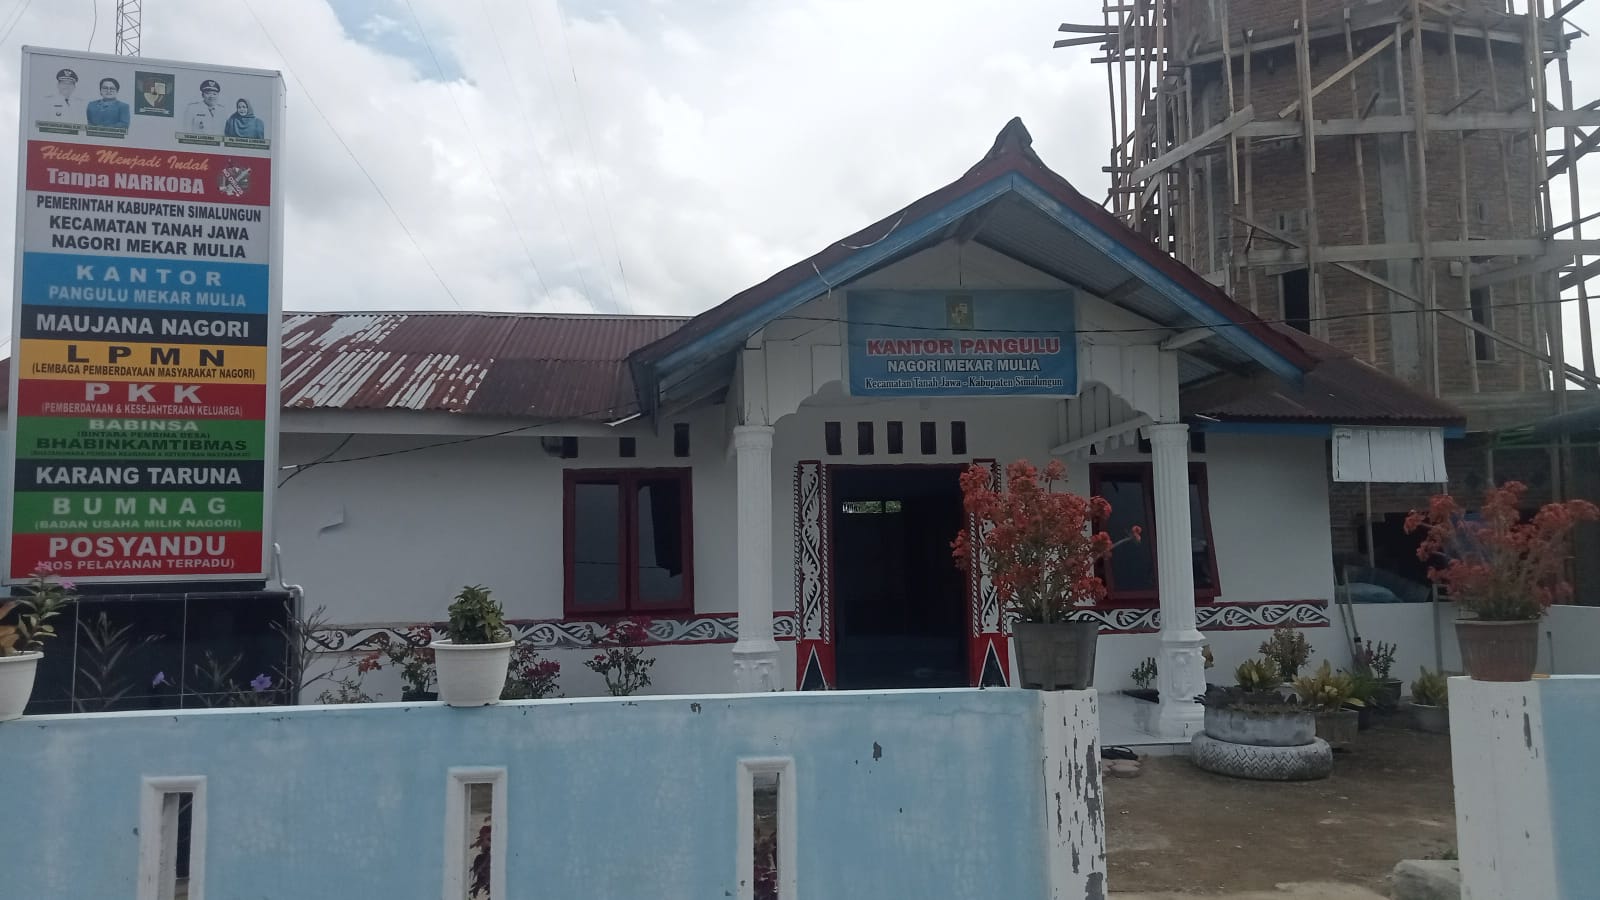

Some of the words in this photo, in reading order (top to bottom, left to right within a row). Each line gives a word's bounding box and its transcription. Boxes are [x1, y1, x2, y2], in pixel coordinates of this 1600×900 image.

[40, 145, 90, 164] Hidup
[96, 150, 161, 168] Menjadi
[168, 155, 208, 171] Indah
[47, 168, 109, 188] Tanpa
[115, 172, 204, 194] NARKOBA
[37, 195, 113, 213] PEMERINTAH
[117, 200, 184, 217] KABUPATEN
[188, 206, 261, 222] SIMALUNGUN
[50, 216, 146, 234] KECAMATAN
[152, 222, 203, 237] TANAH
[208, 226, 249, 240] JAWA
[52, 235, 120, 251] NAGORI
[127, 239, 186, 255] MEKAR
[193, 243, 246, 258] MULIA
[50, 286, 128, 302] PANGULU
[134, 290, 190, 304] MEKAR
[197, 293, 246, 307] MULIA
[36, 314, 154, 335] MAUJANA
[162, 319, 248, 337] NAGORI
[867, 339, 953, 356] KANTOR
[960, 337, 1060, 355] PANGULU
[33, 365, 80, 375] (LEMBAGA
[83, 366, 154, 376] PEMBERDAYAAN
[158, 368, 216, 378] MASYARAKAT
[218, 369, 255, 379] NAGORI)
[888, 360, 941, 372] NAGORI
[945, 360, 993, 371] MEKAR
[997, 359, 1040, 371] MULIA
[865, 378, 912, 388] Kecamatan
[913, 376, 939, 388] Tanah
[940, 376, 961, 388] Jawa
[968, 376, 1014, 389] Kabupaten
[1015, 375, 1063, 388] Simalungun
[42, 403, 113, 414] (PEMBERDAYAAN
[116, 405, 122, 413] &
[125, 404, 194, 415] KESEJAHTERAAN
[198, 406, 242, 416] KELUARGA)
[89, 420, 198, 431] BABINSA
[36, 438, 246, 450] BHABINKAMTIBMAS
[36, 467, 139, 484] KARANG
[148, 468, 241, 484] TARUNA
[35, 520, 88, 530] (BADAN
[92, 520, 139, 529] USAHA
[144, 520, 181, 528] MILIK
[186, 519, 241, 528] NAGORI)
[50, 536, 225, 557] POSYANDU
[77, 560, 160, 570] PELAYANAN
[167, 559, 234, 569] TERPADU)
